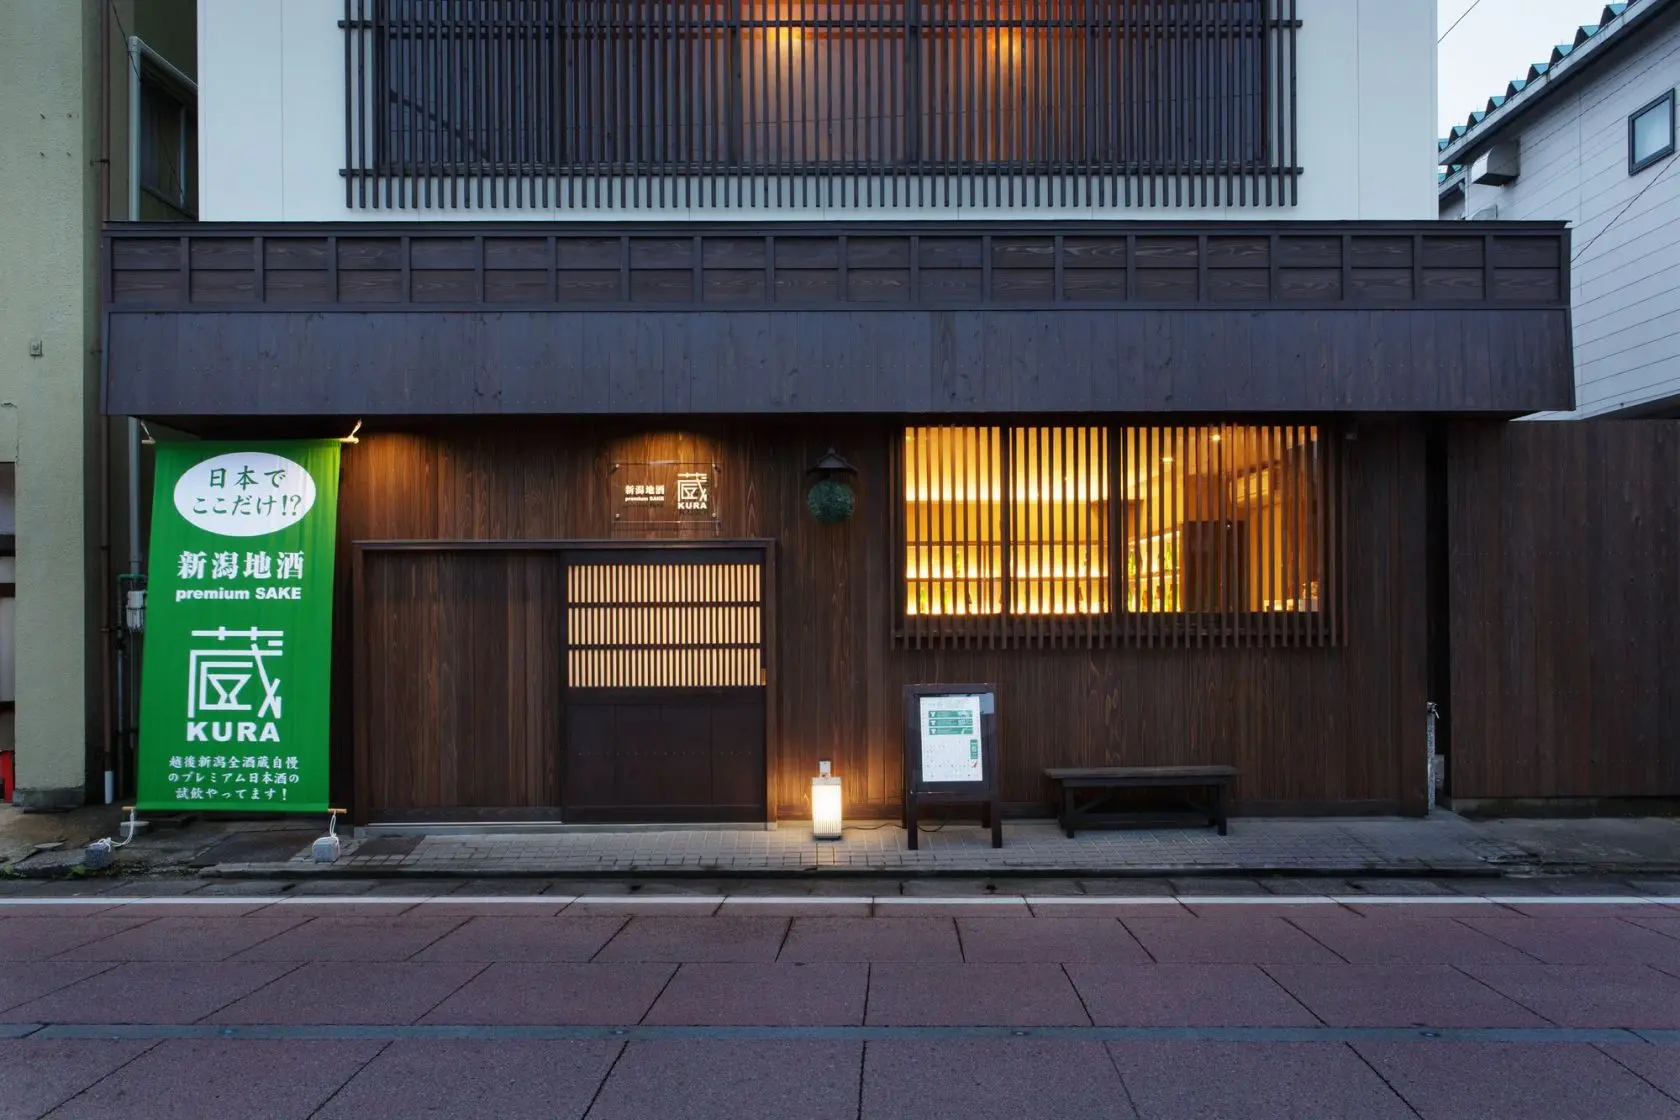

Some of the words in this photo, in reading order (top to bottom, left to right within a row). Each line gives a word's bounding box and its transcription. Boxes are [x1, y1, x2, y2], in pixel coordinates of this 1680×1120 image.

[209, 465, 286, 490] 日本で
[176, 551, 304, 580] 新潟地酒
[176, 587, 250, 602] premium
[255, 587, 302, 600] SAKE
[186, 721, 280, 742] KURA
[168, 755, 299, 769] 越後新潟全酒蔵自慢
[168, 772, 299, 784] のプレミアム日本酒の
